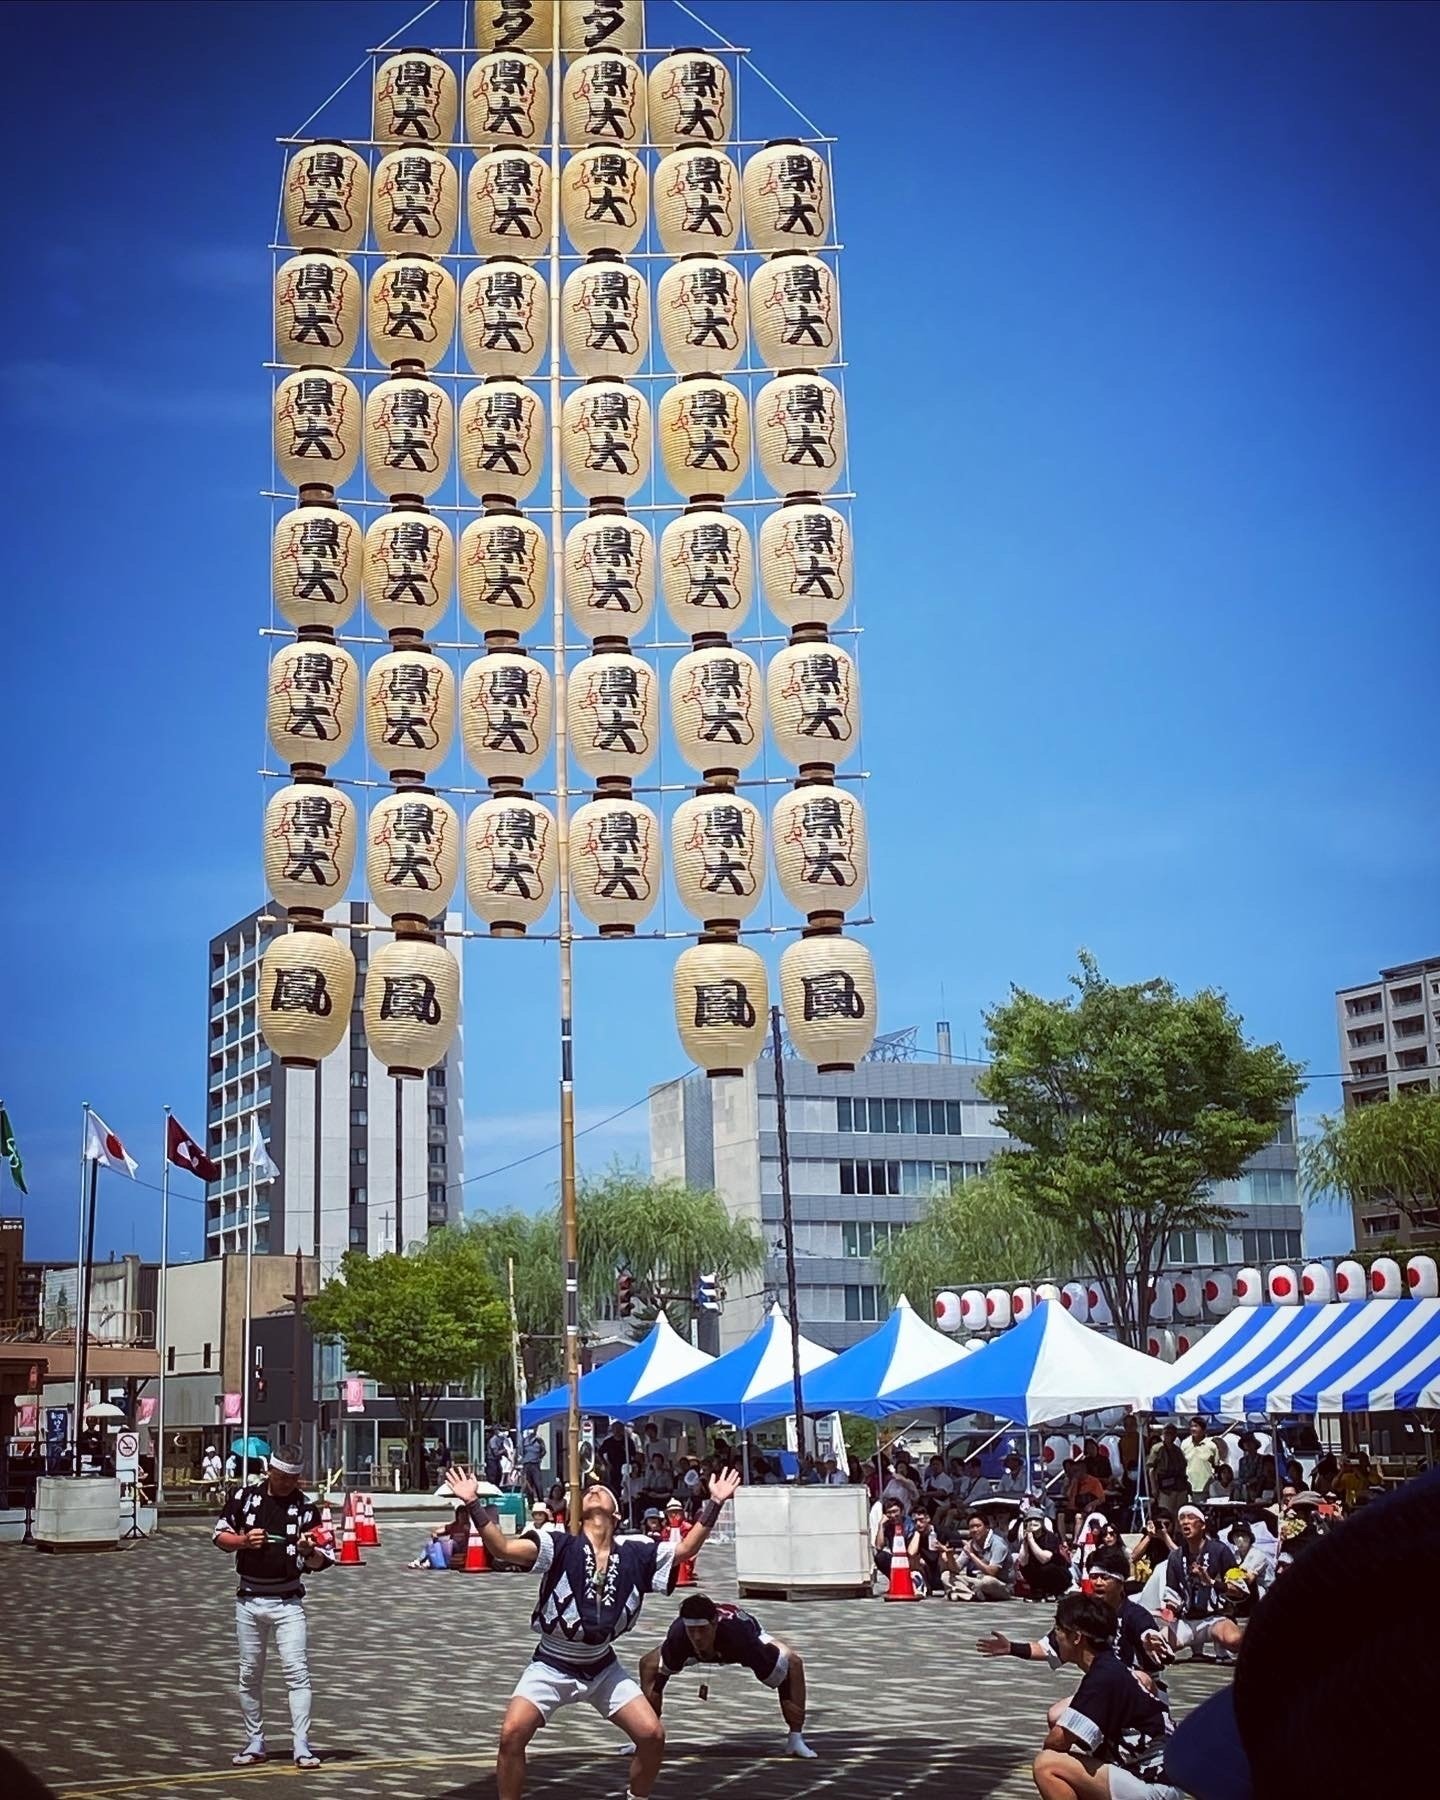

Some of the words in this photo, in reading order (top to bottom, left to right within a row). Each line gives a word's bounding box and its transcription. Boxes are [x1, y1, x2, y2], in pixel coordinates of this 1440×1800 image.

[395, 60, 432, 140] 県大
[489, 58, 527, 137] 県大
[589, 60, 627, 140] 県大
[681, 61, 716, 138] 県大
[303, 152, 345, 230] 県大
[395, 157, 432, 237] 県大
[495, 157, 532, 238] 県大
[589, 153, 629, 224] 県大
[686, 156, 723, 236] 県大
[780, 154, 817, 236] 県大
[296, 263, 335, 346] 県大
[387, 265, 429, 339] 県大
[486, 272, 524, 353] 県大
[593, 272, 633, 352] 県大
[692, 268, 730, 349] 県大
[786, 264, 824, 345] 県大
[296, 378, 335, 459] 県大
[390, 389, 429, 471] 県大
[486, 393, 524, 475] 県大
[593, 393, 633, 473] 県大
[693, 390, 730, 471] 県大
[788, 386, 826, 466] 県大
[298, 517, 340, 602] 県大
[387, 523, 429, 604] 県大
[485, 526, 527, 607] 県大
[593, 527, 634, 611] 県大
[691, 522, 730, 607] 県大
[799, 513, 837, 598] 県大
[291, 653, 334, 739] 県大
[387, 664, 429, 749] 県大
[487, 665, 529, 753] 県大
[597, 666, 639, 753] 県大
[702, 658, 743, 744] 県大
[803, 654, 843, 740] 県大
[288, 797, 332, 885] 県大
[390, 802, 433, 889] 県大
[491, 808, 534, 898] 県大
[600, 811, 643, 897] 県大
[704, 807, 744, 895] 県大
[803, 797, 845, 885] 県大
